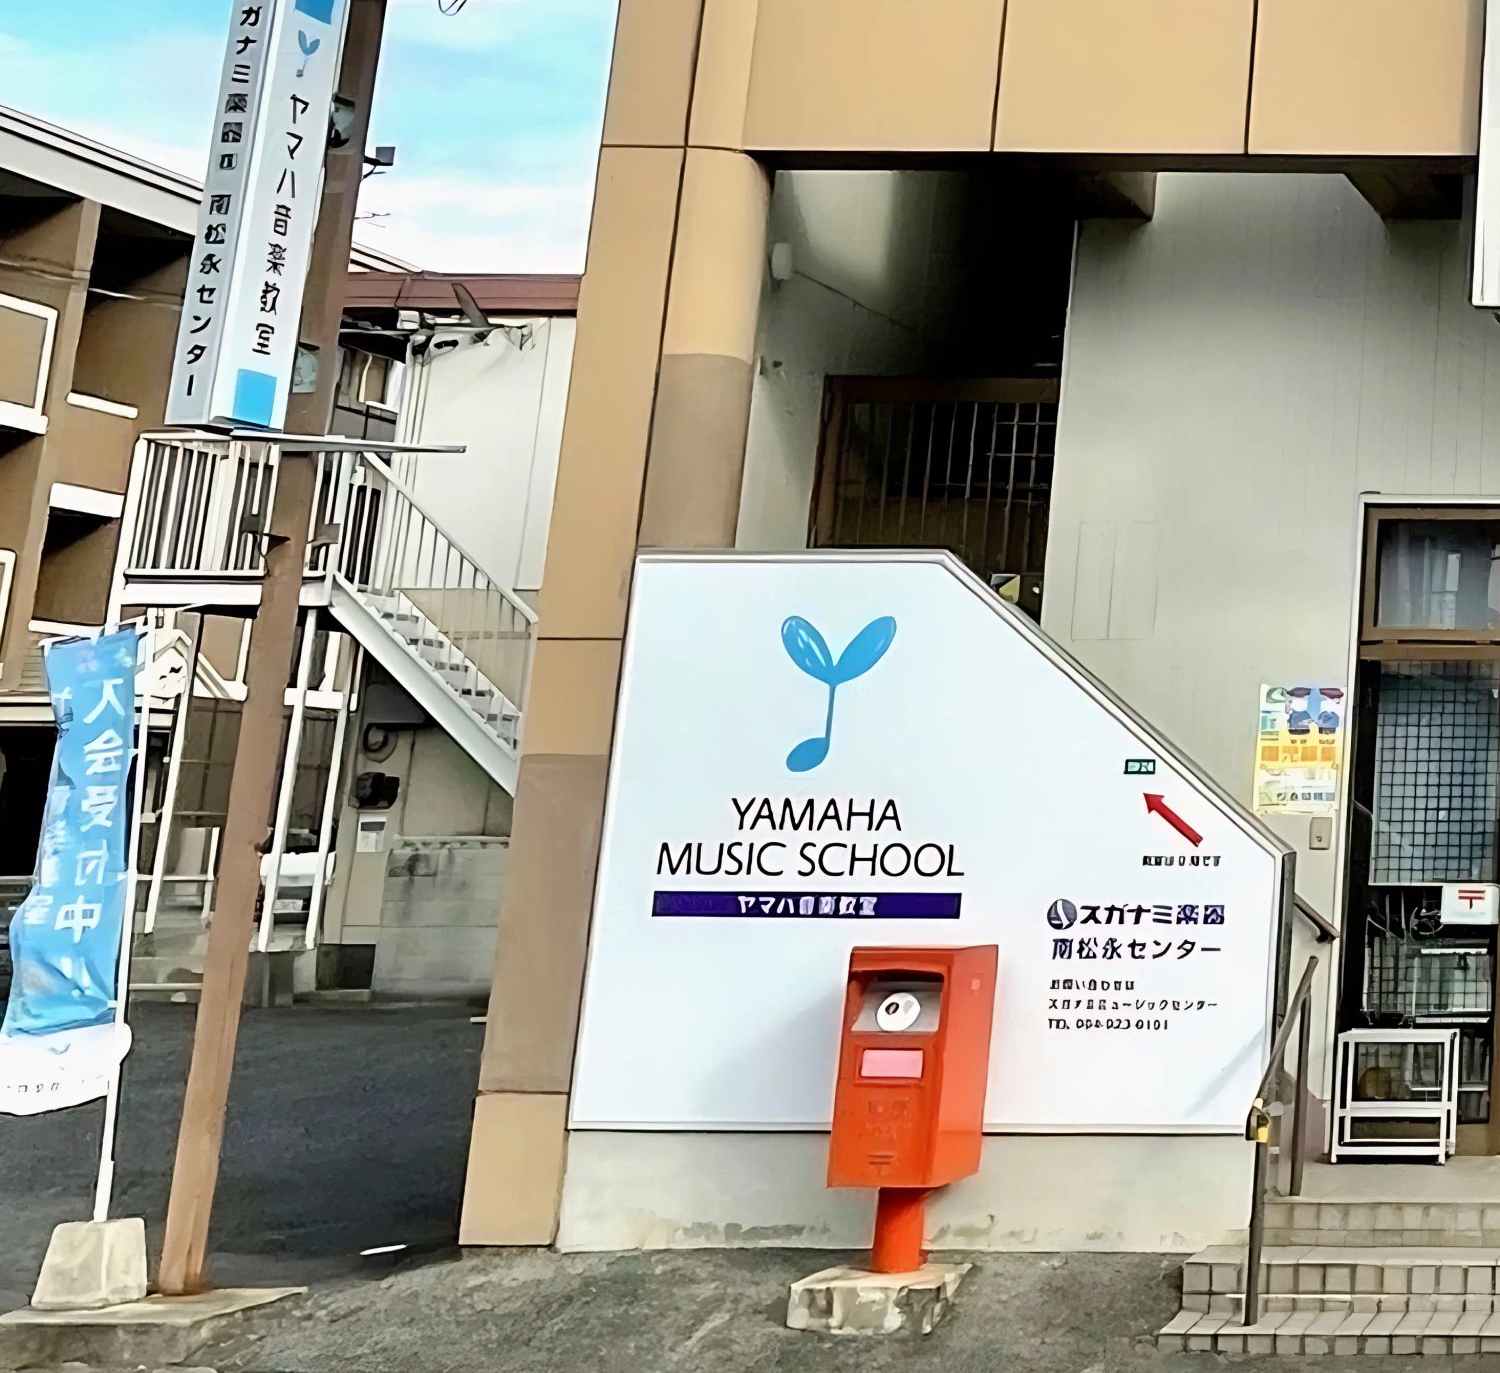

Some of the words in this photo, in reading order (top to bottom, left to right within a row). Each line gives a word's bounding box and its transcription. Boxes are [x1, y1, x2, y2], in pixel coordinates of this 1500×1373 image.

[252, 94, 310, 355] ヤマハ音楽教室
[731, 796, 902, 832] YAMAHA
[656, 841, 787, 876] MUSIC
[797, 841, 965, 877] SCHOOL
